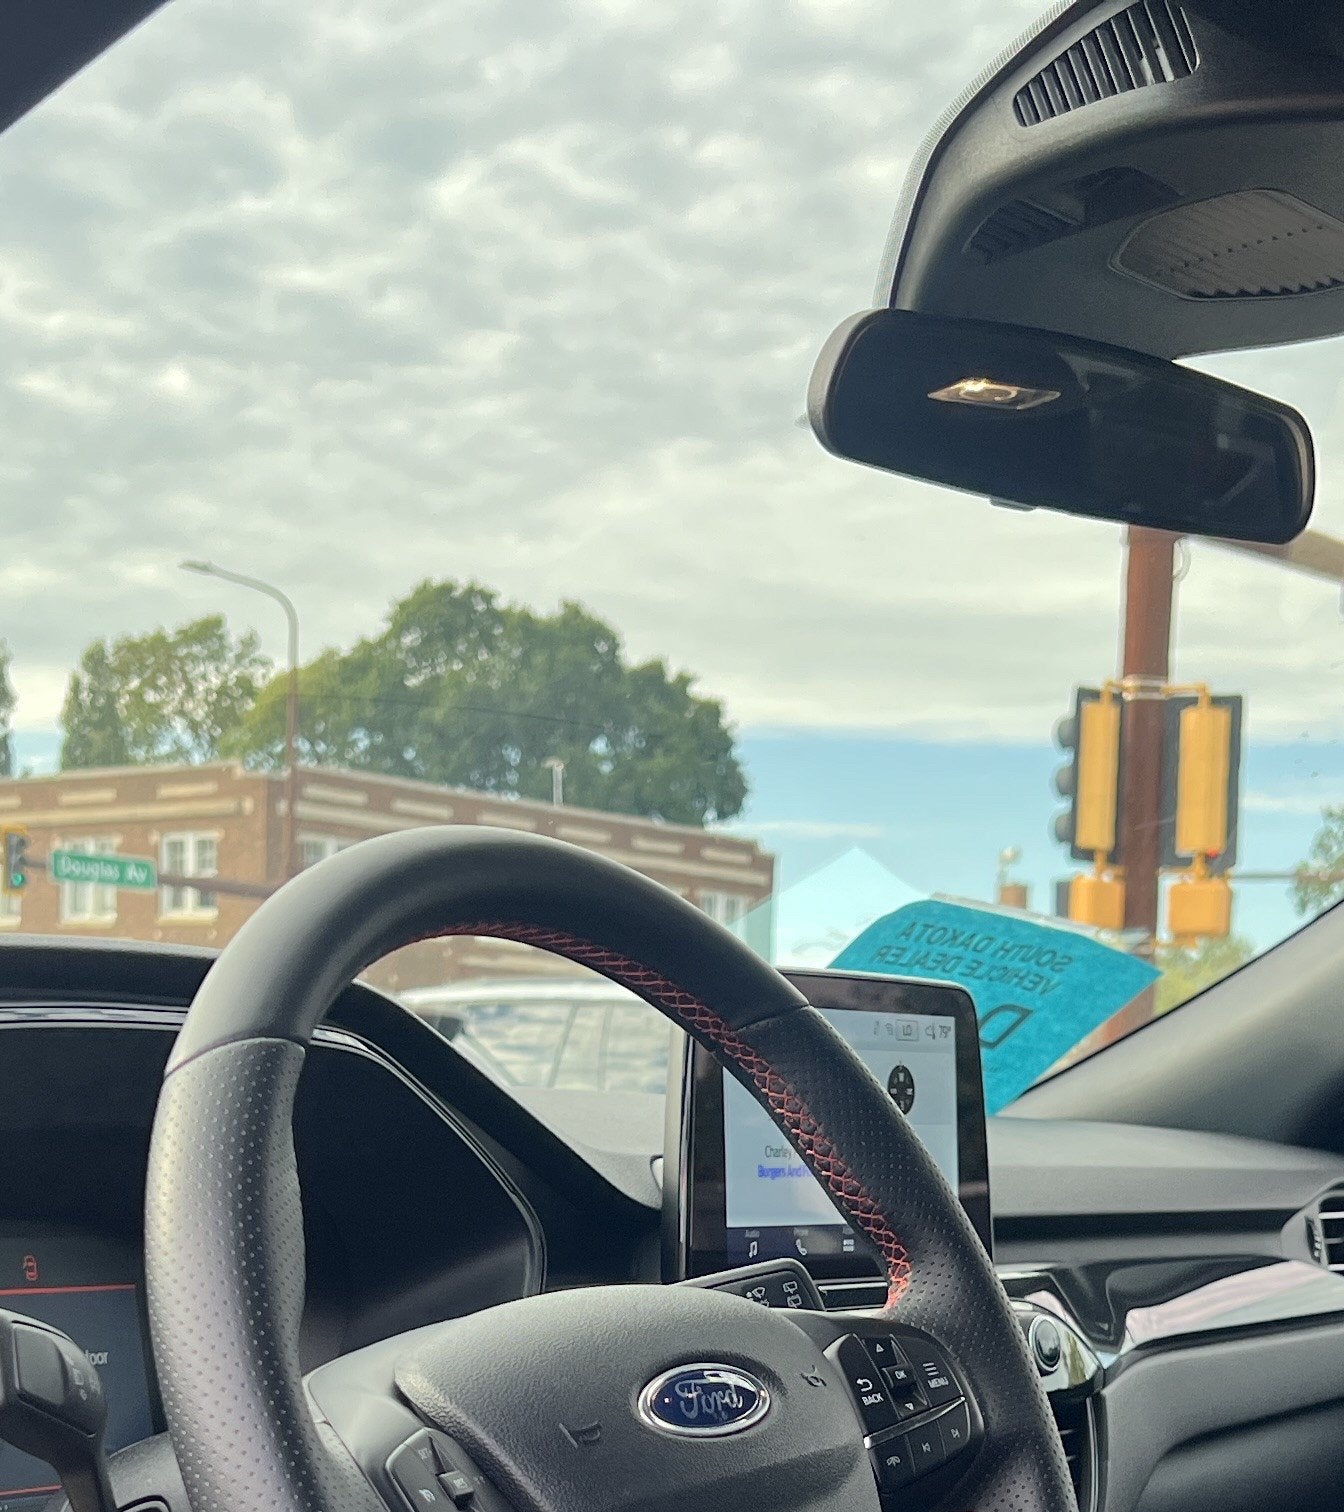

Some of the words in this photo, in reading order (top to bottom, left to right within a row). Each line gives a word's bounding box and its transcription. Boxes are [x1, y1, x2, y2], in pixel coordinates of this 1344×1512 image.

[62, 855, 120, 881] Douglas
[85, 1350, 109, 1365] oor
[674, 1378, 744, 1420] Ford
[862, 1393, 884, 1406] BACK
